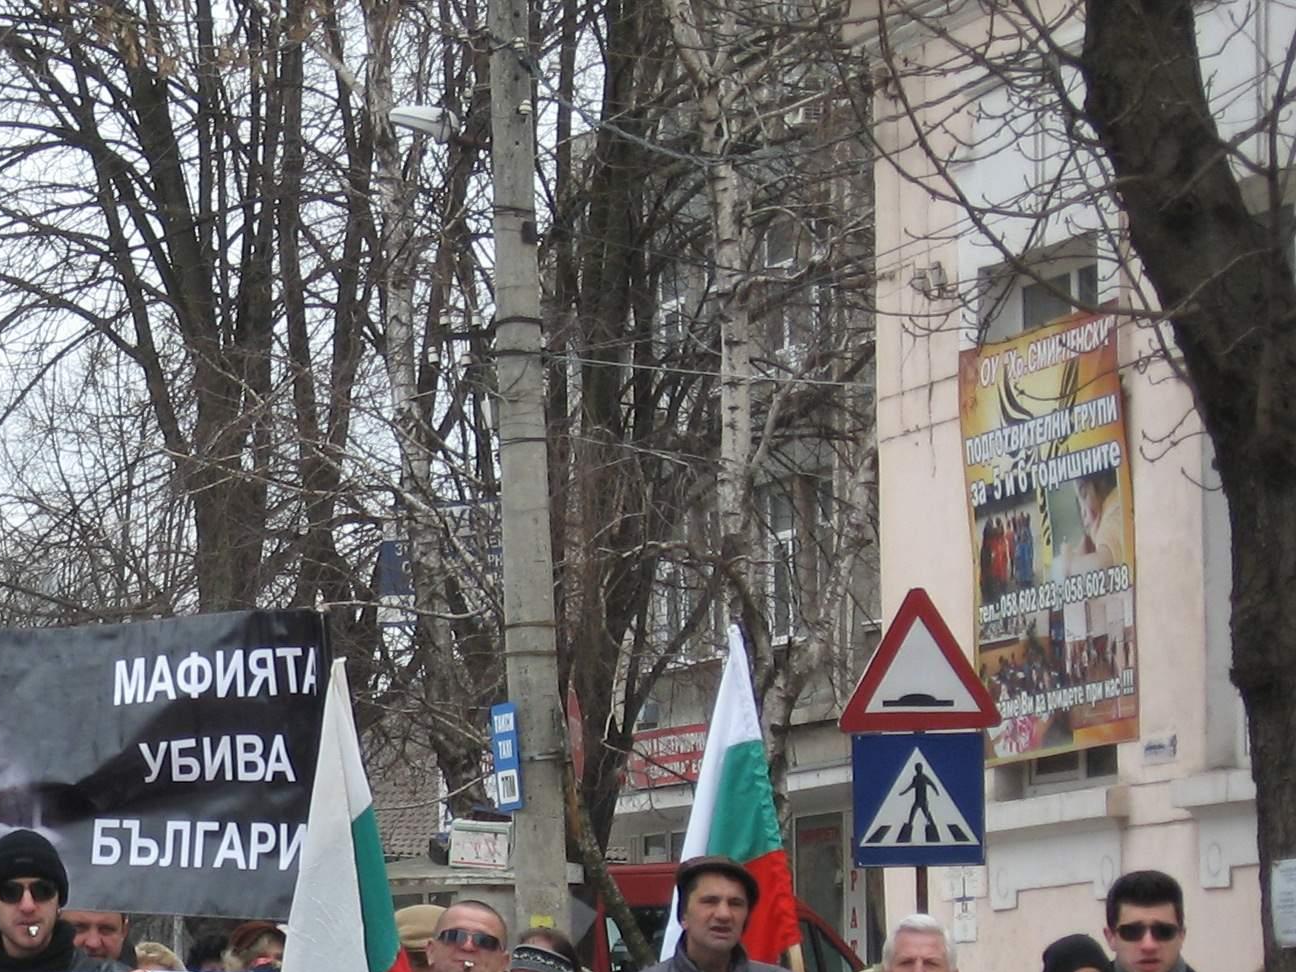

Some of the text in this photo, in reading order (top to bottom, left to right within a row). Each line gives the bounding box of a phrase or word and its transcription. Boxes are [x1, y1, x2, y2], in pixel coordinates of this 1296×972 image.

[980, 357, 999, 388] ОУ
[966, 395, 1119, 465] ПОДГОТВИТЕЛНИ ГРУПИ
[970, 480, 987, 506] за
[993, 466, 1002, 500] 5
[1017, 460, 1028, 493] 6
[1031, 441, 1121, 491] годишните
[1019, 588, 1037, 612] 602
[1064, 576, 1082, 602] 058
[1086, 571, 1105, 596] 602
[1108, 565, 1129, 592] 798
[113, 647, 318, 706] МАФИЯТА
[138, 734, 297, 783] УБИВА
[91, 819, 308, 871] БЪЛГАРИ
